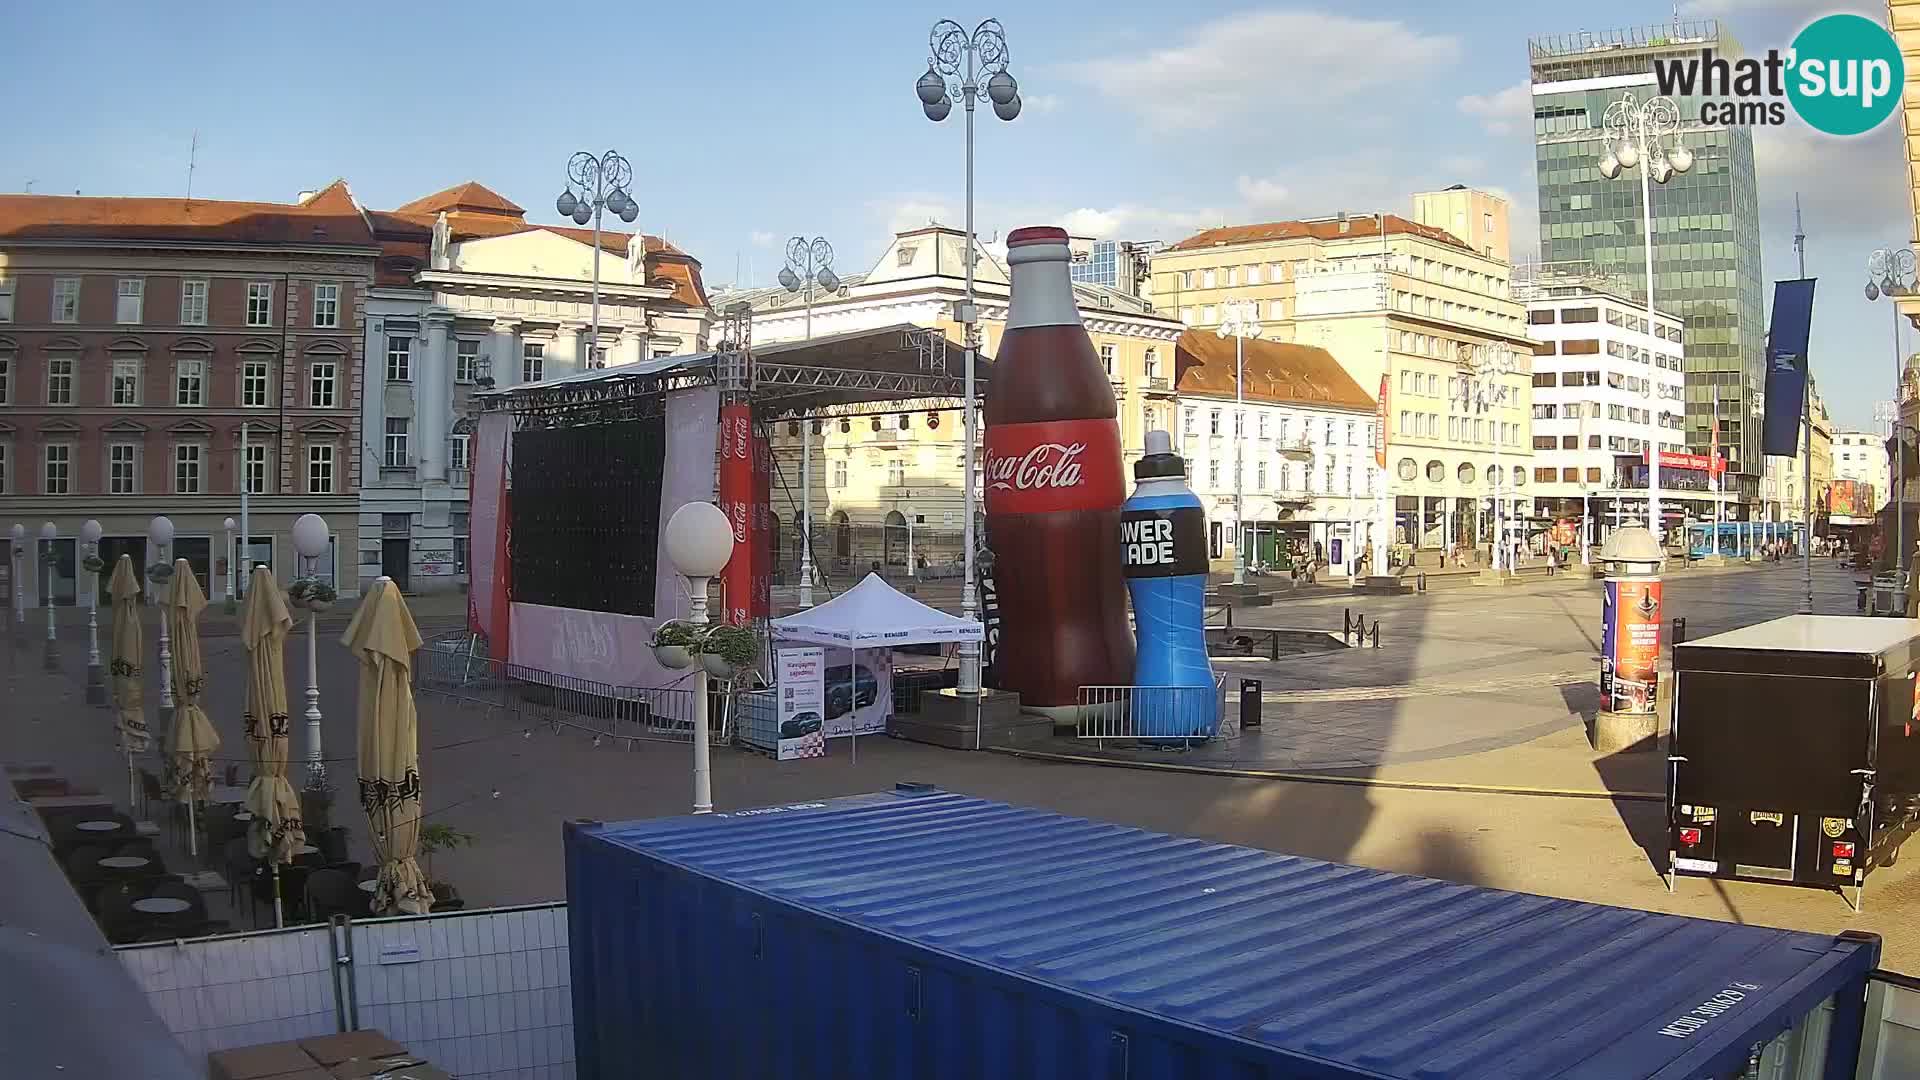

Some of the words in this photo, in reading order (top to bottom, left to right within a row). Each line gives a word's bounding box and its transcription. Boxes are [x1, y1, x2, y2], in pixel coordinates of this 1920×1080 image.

[734, 416, 748, 459] Coca-Cola
[734, 501, 747, 543] Coca-Cola
[1657, 1015, 1709, 1038] MCDU
[1691, 988, 1747, 1019] 300629
